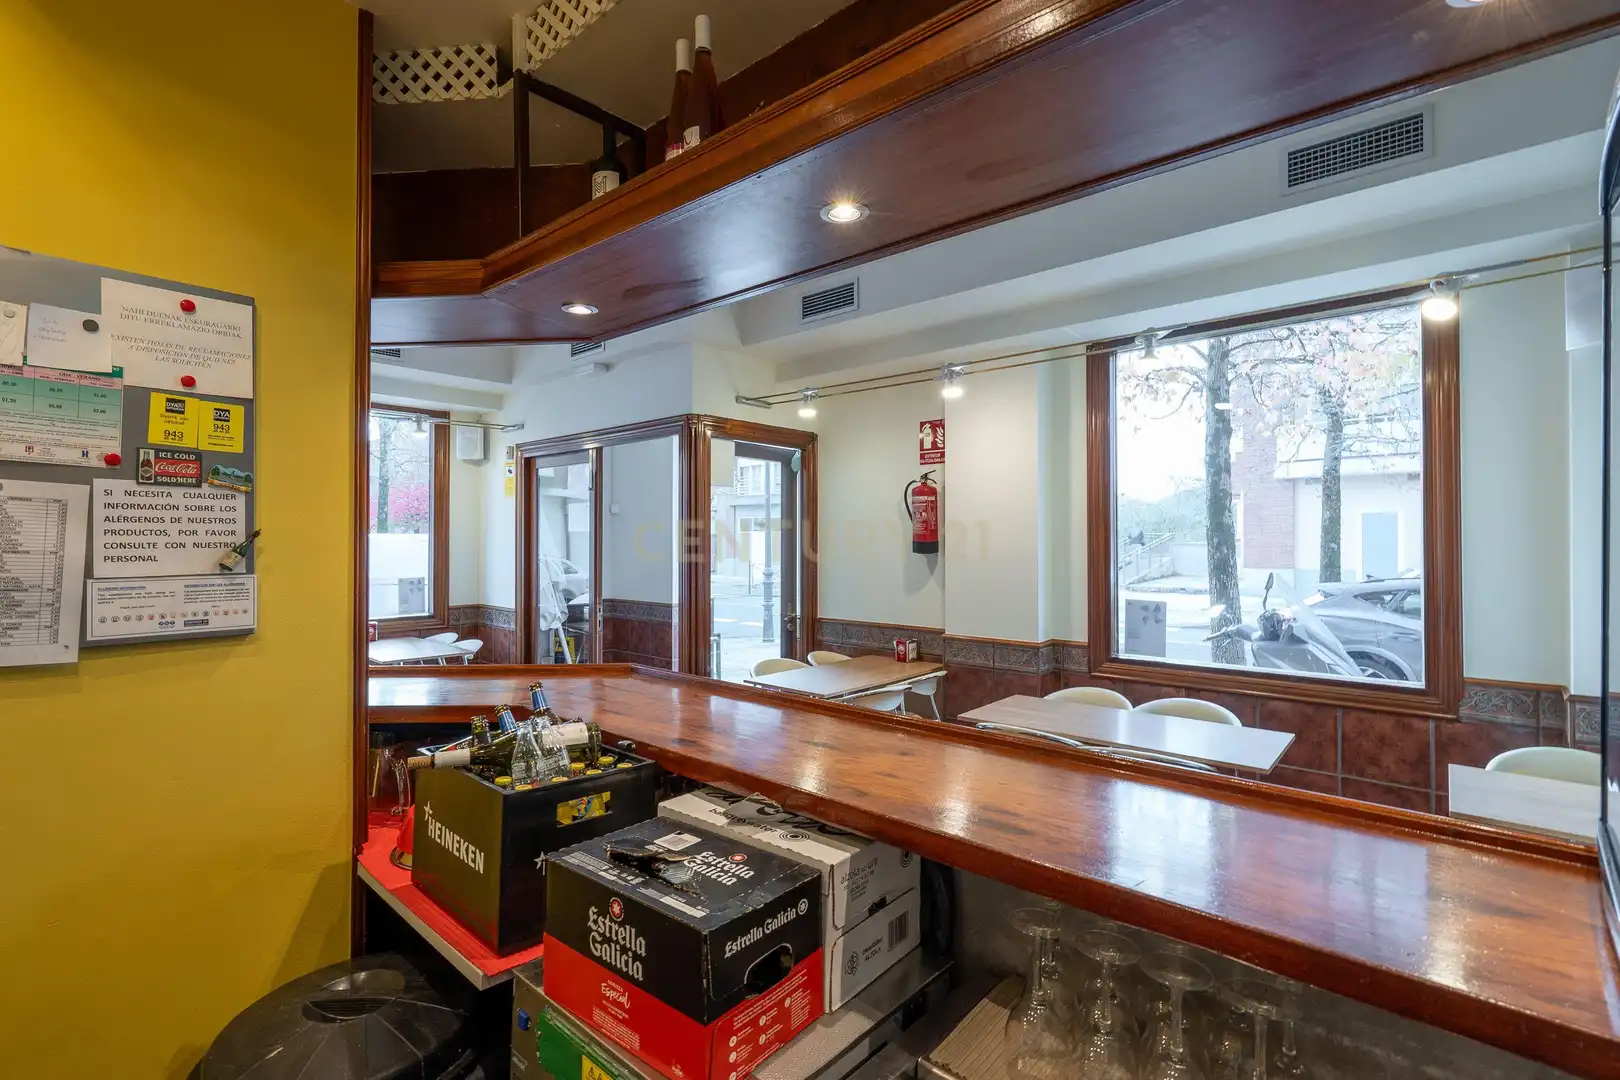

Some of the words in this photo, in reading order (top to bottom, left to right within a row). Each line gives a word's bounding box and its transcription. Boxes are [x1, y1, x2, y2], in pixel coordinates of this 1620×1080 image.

[121, 305, 144, 317] NAHI
[146, 311, 182, 322] DUENAK
[184, 317, 242, 332] ESKURAGARRI
[120, 313, 141, 322] DITU
[144, 317, 210, 334] ERREKLAMAZIO
[211, 329, 243, 339] ORRIAK
[110, 334, 145, 344] EXISTEN
[147, 339, 173, 349] HOJAS
[188, 345, 252, 360] RECLAMACIONES
[171, 359, 212, 369] SOLICITEN
[202, 356, 237, 365] QUIENES
[213, 410, 231, 418] DYA
[163, 429, 184, 438] 943
[213, 424, 231, 432] 943
[159, 451, 173, 459] ICE
[174, 452, 196, 460] COLD
[124, 490, 173, 499] NECESITA
[183, 492, 237, 501] CUALQUIER
[103, 502, 180, 511] INFORMACIÓN
[184, 504, 216, 512] SOBRE
[219, 505, 237, 513] LOS
[103, 514, 165, 524] ALÉRGENOS
[170, 516, 183, 524] DE
[187, 516, 237, 525] NUESTROS
[103, 529, 171, 538] PRODUCTOS,
[178, 529, 199, 537] POR
[205, 529, 237, 537] FAVOR
[103, 541, 158, 550] CONSULTE
[164, 541, 186, 549] CON
[192, 541, 237, 549] NUESTRO
[103, 555, 159, 563] PERSONAL
[427, 817, 485, 875] HEINEKEN
[694, 851, 756, 880] Estrella
[684, 858, 738, 887] Galicia
[587, 905, 647, 957] Estrella
[724, 925, 764, 959] Estrella
[764, 907, 797, 934] Galicia
[589, 930, 645, 982] Galicia
[600, 983, 631, 1009] Especial
